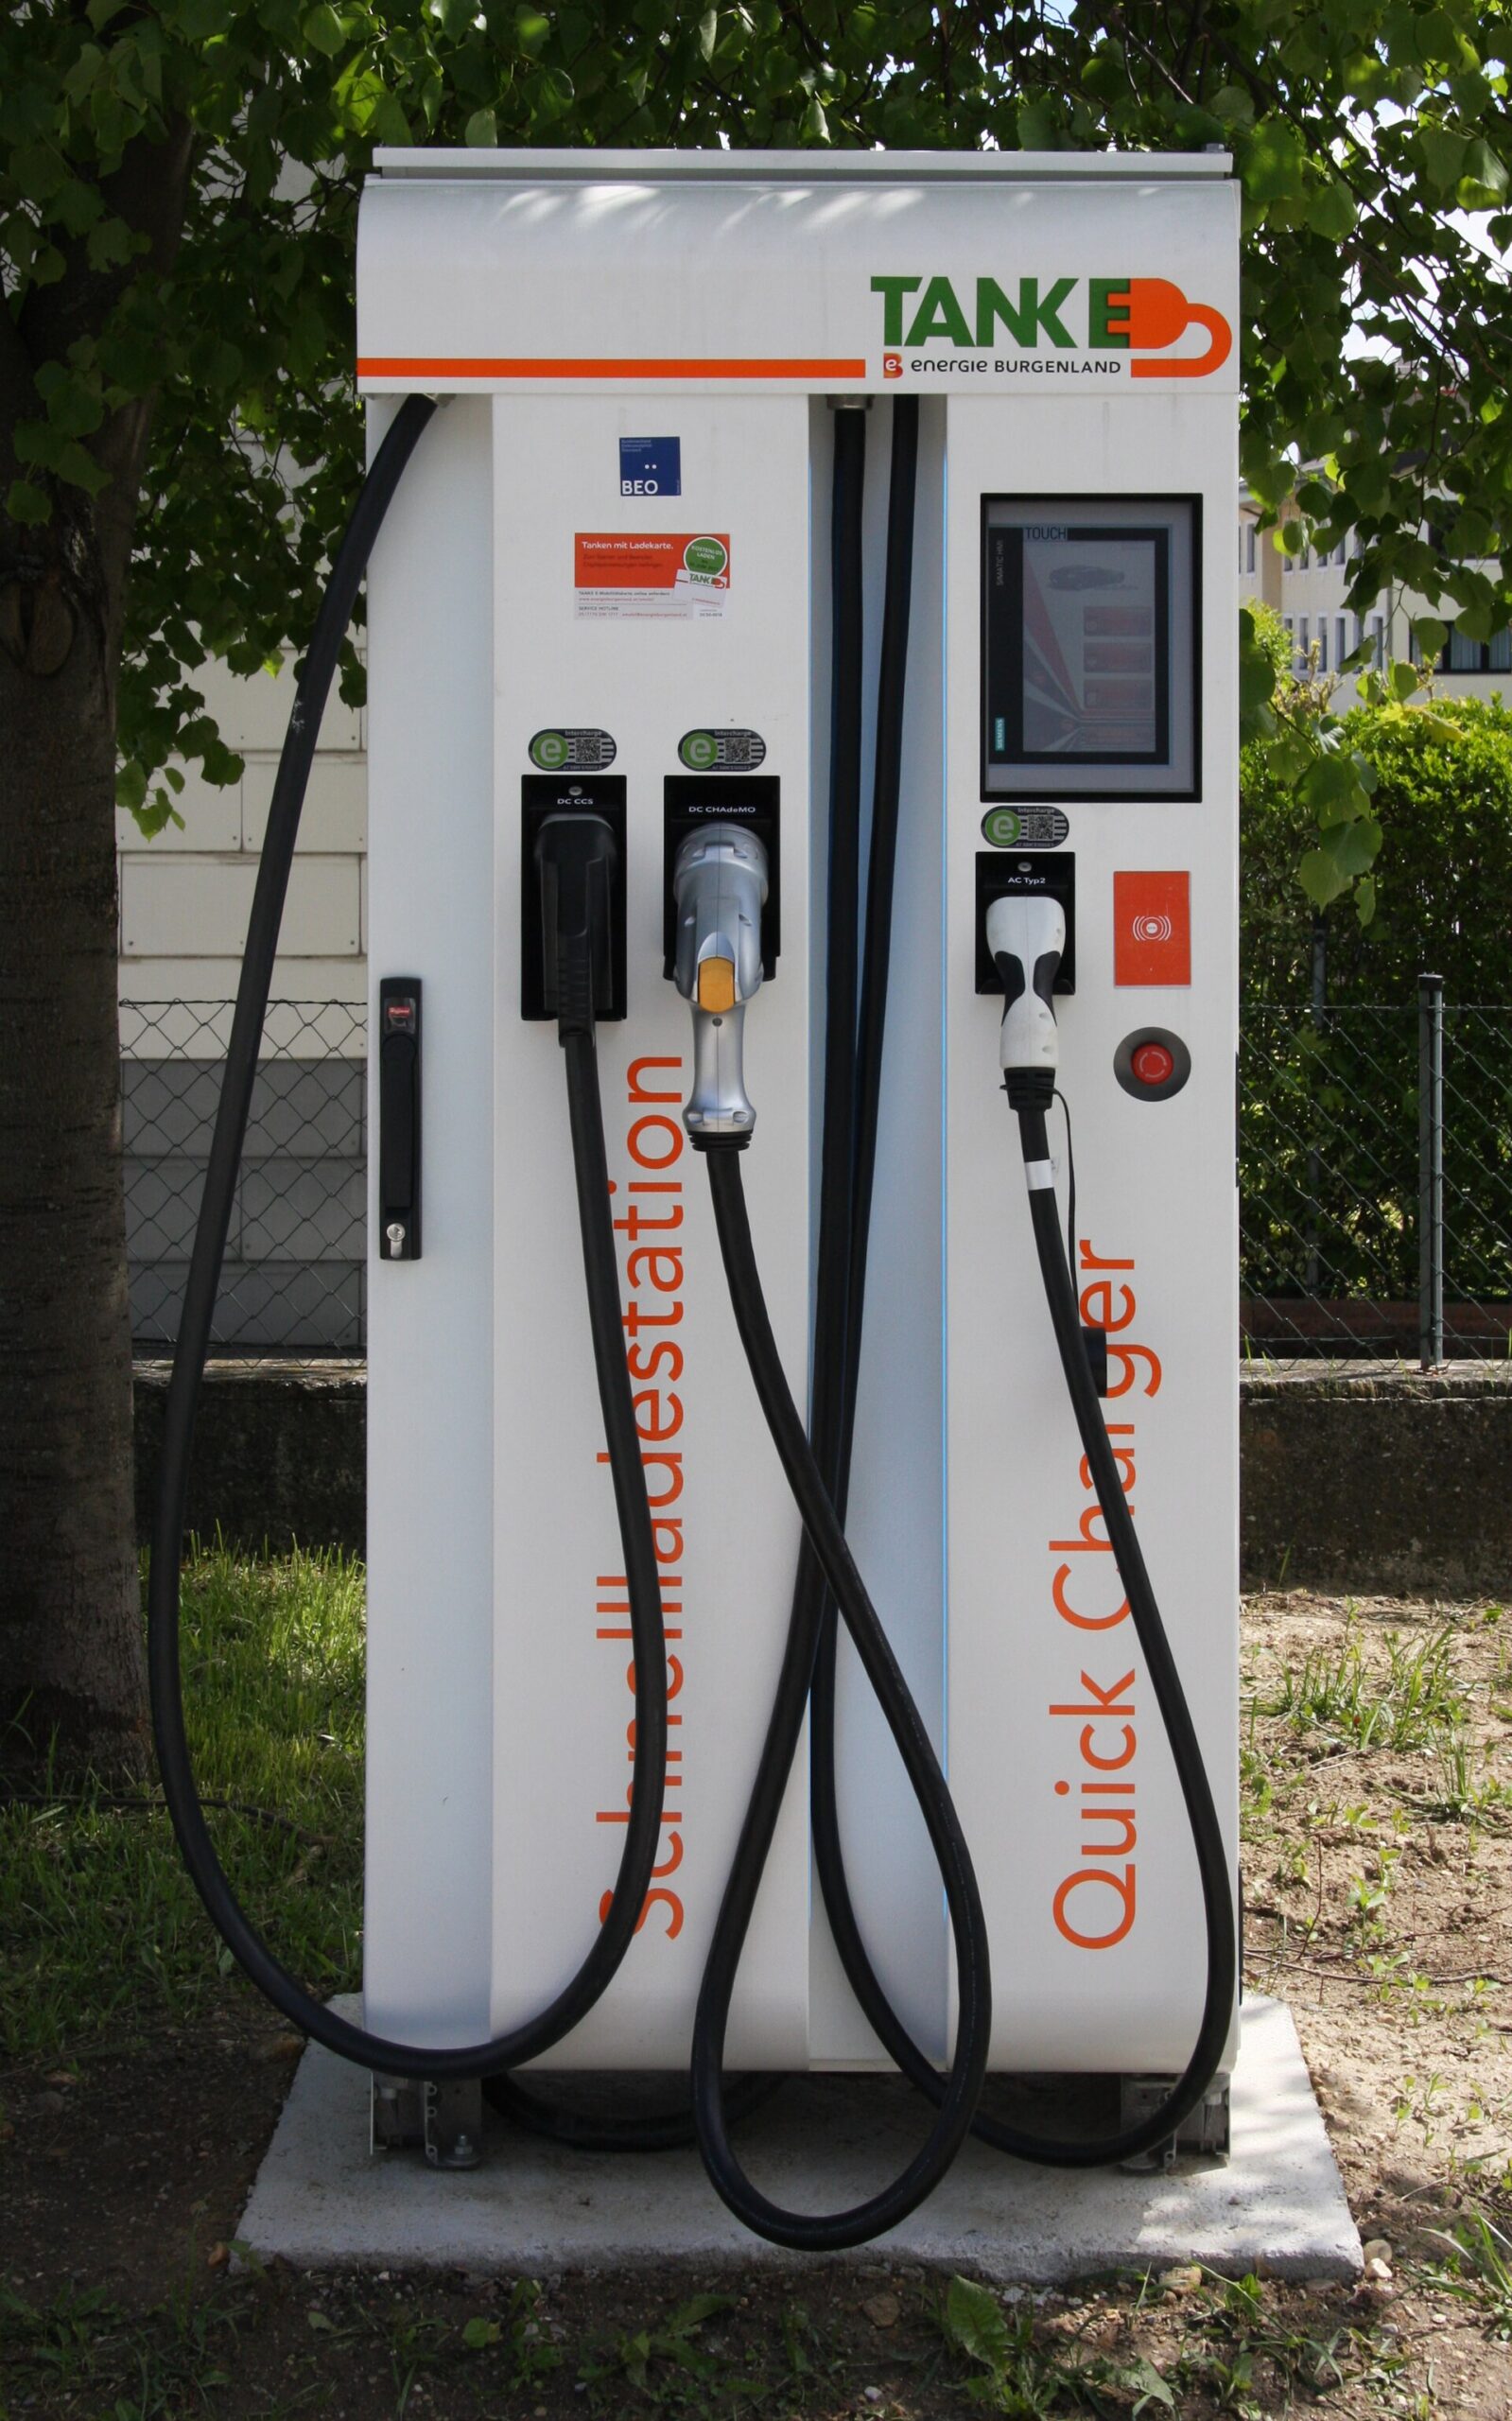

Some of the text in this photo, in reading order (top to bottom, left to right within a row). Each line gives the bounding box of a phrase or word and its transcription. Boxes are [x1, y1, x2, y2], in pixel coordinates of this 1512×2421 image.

[871, 276, 1130, 349] TANKE
[911, 358, 988, 374] energie
[994, 358, 1121, 374] BURGENLAND
[621, 479, 659, 496] BEO
[1024, 526, 1067, 541] TOUCH
[582, 541, 673, 550] Tanken mit Ladekarte.
[1008, 876, 1046, 886] AC Typ2
[1049, 1668, 1138, 1950] Quick
